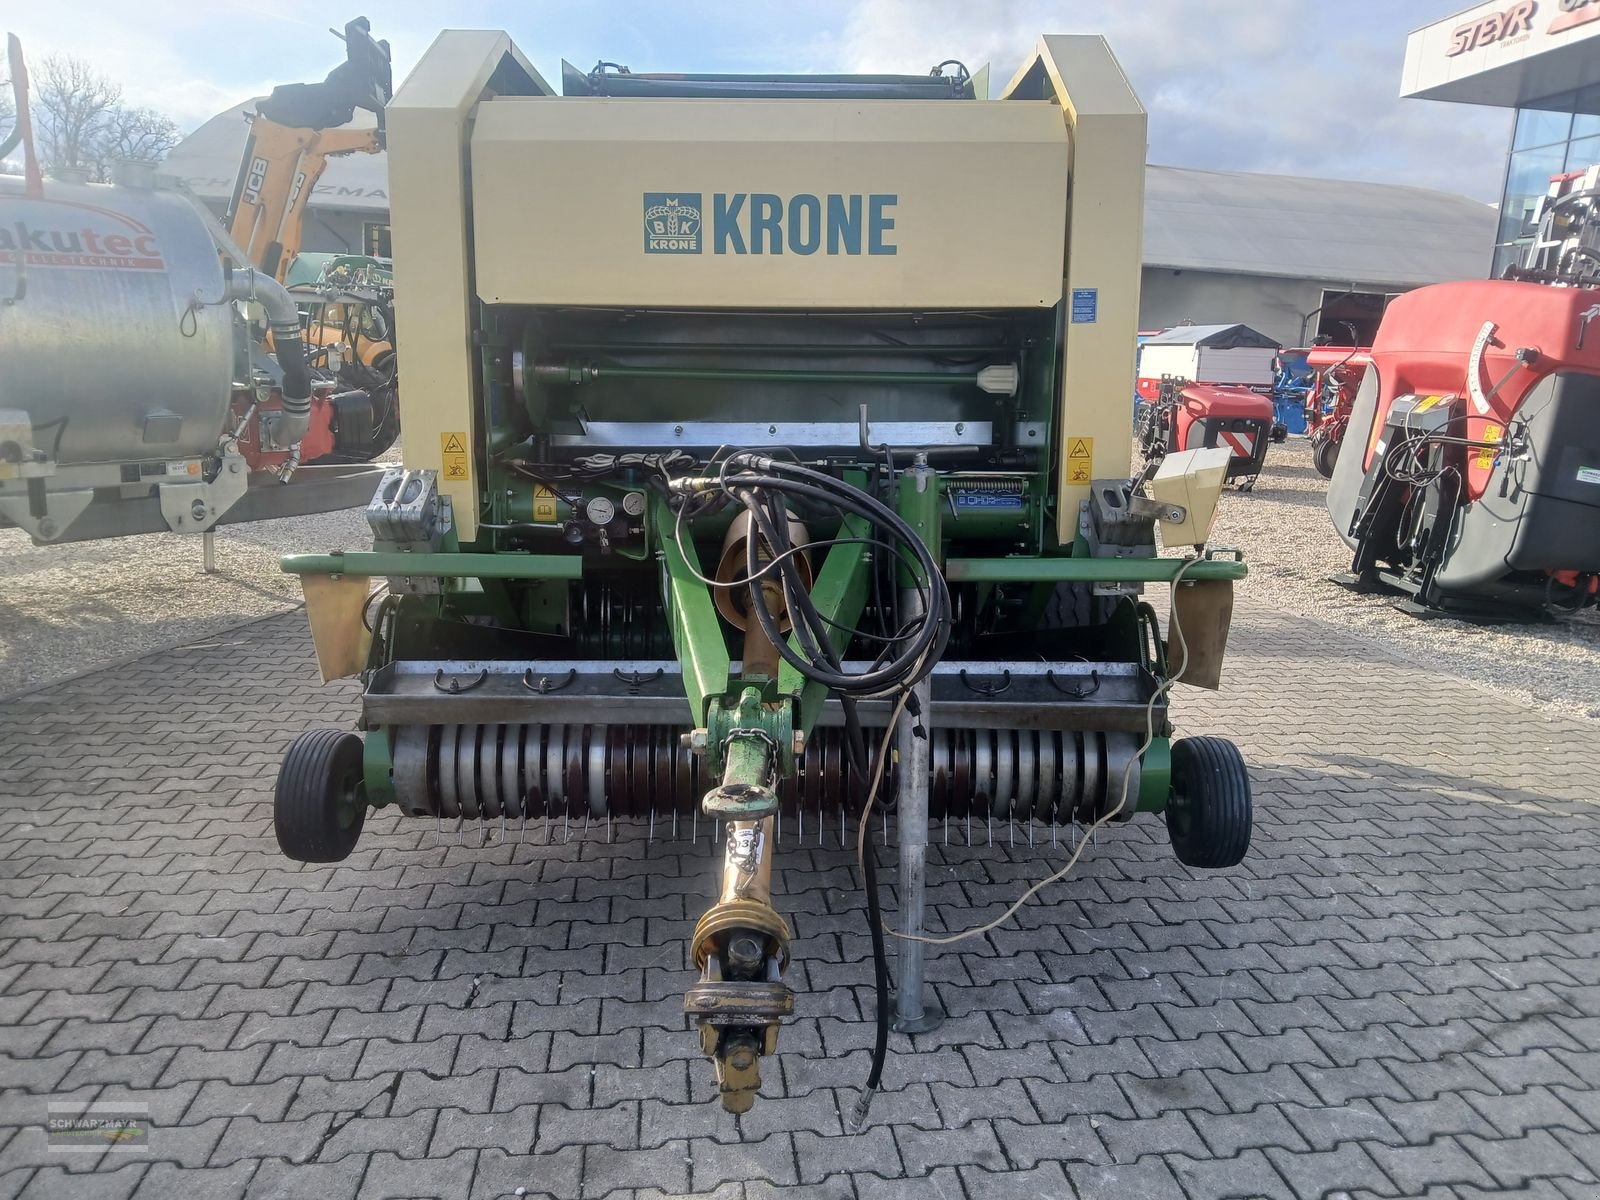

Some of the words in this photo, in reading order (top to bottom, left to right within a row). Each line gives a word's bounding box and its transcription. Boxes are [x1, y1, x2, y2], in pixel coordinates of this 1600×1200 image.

[1445, 0, 1538, 57] STEYR
[243, 158, 268, 205] JCB
[649, 239, 697, 250] KRONE
[713, 193, 898, 256] KRONE
[8, 252, 136, 267] GLLE-TECHNIK
